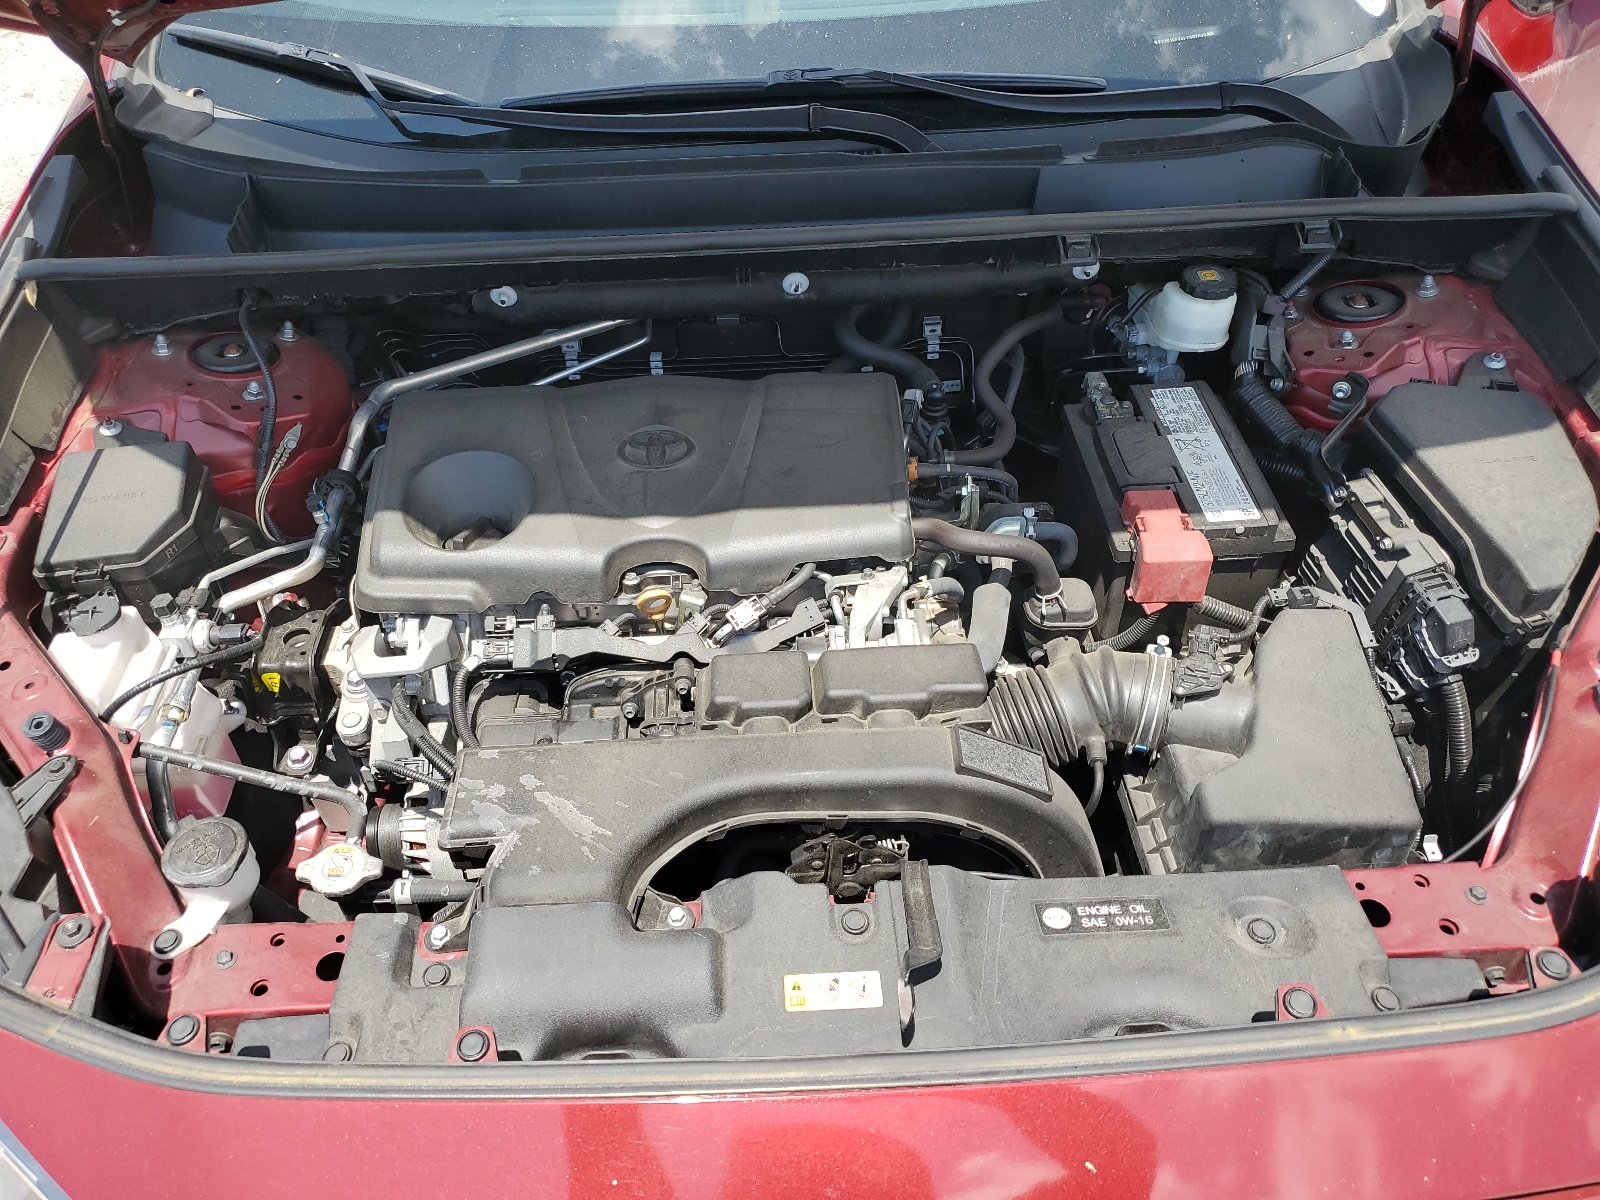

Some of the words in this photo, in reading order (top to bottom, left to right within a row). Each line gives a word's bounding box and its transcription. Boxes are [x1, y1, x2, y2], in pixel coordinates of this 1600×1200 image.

[165, 543, 178, 559] R1
[1077, 905, 1122, 915] ENGINE
[1129, 904, 1150, 913] OIL
[1081, 917, 1107, 928] SAE
[1115, 915, 1154, 926] 0W-16
